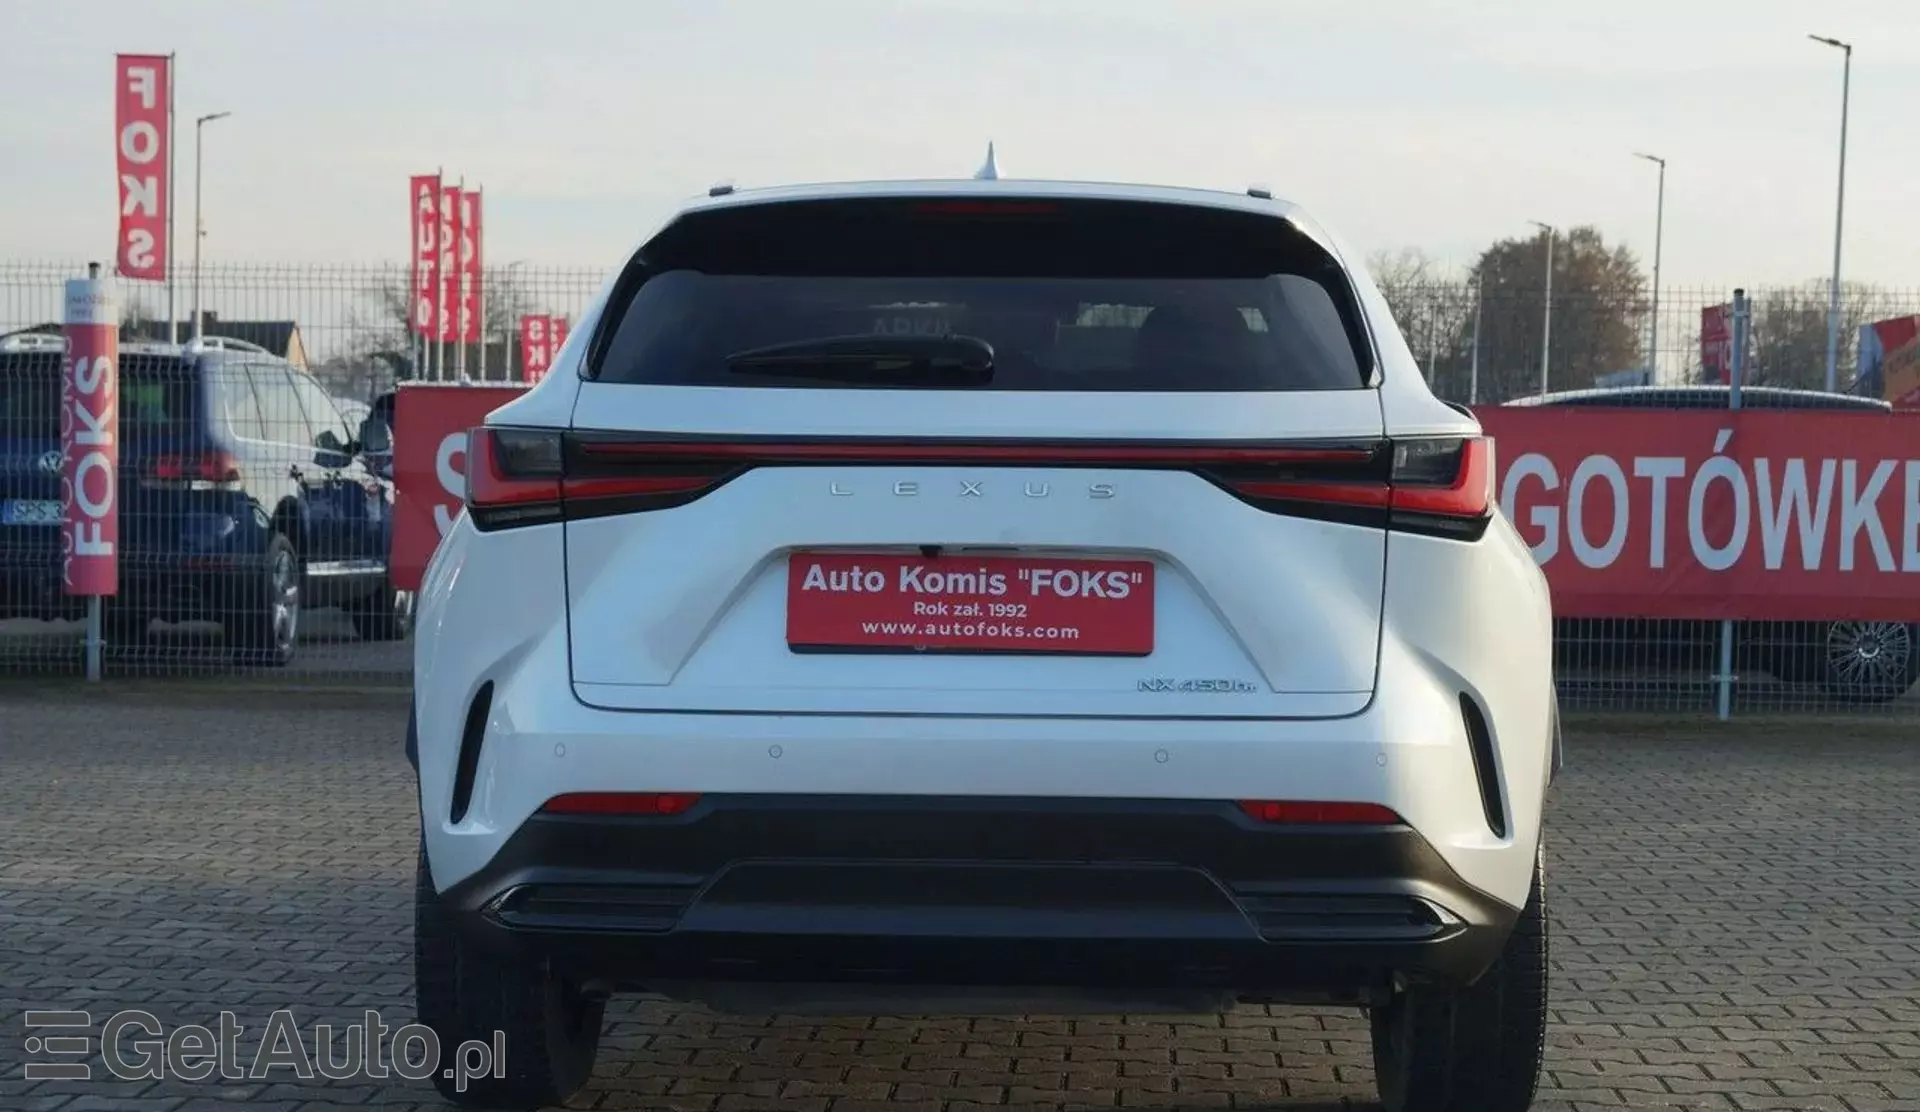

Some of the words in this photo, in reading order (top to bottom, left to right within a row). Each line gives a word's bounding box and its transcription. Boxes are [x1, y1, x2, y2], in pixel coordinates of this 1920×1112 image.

[75, 355, 113, 555] FOKS
[830, 481, 1116, 499] LEXUS
[802, 563, 885, 592] Auto
[900, 566, 1008, 595] Komis
[1018, 568, 1143, 599] "FOKS"
[914, 601, 948, 616] Rok
[953, 602, 983, 617] zał.
[988, 603, 1027, 618] 1992
[862, 621, 1080, 640] www.autofoks.com
[1137, 679, 1175, 692] NX
